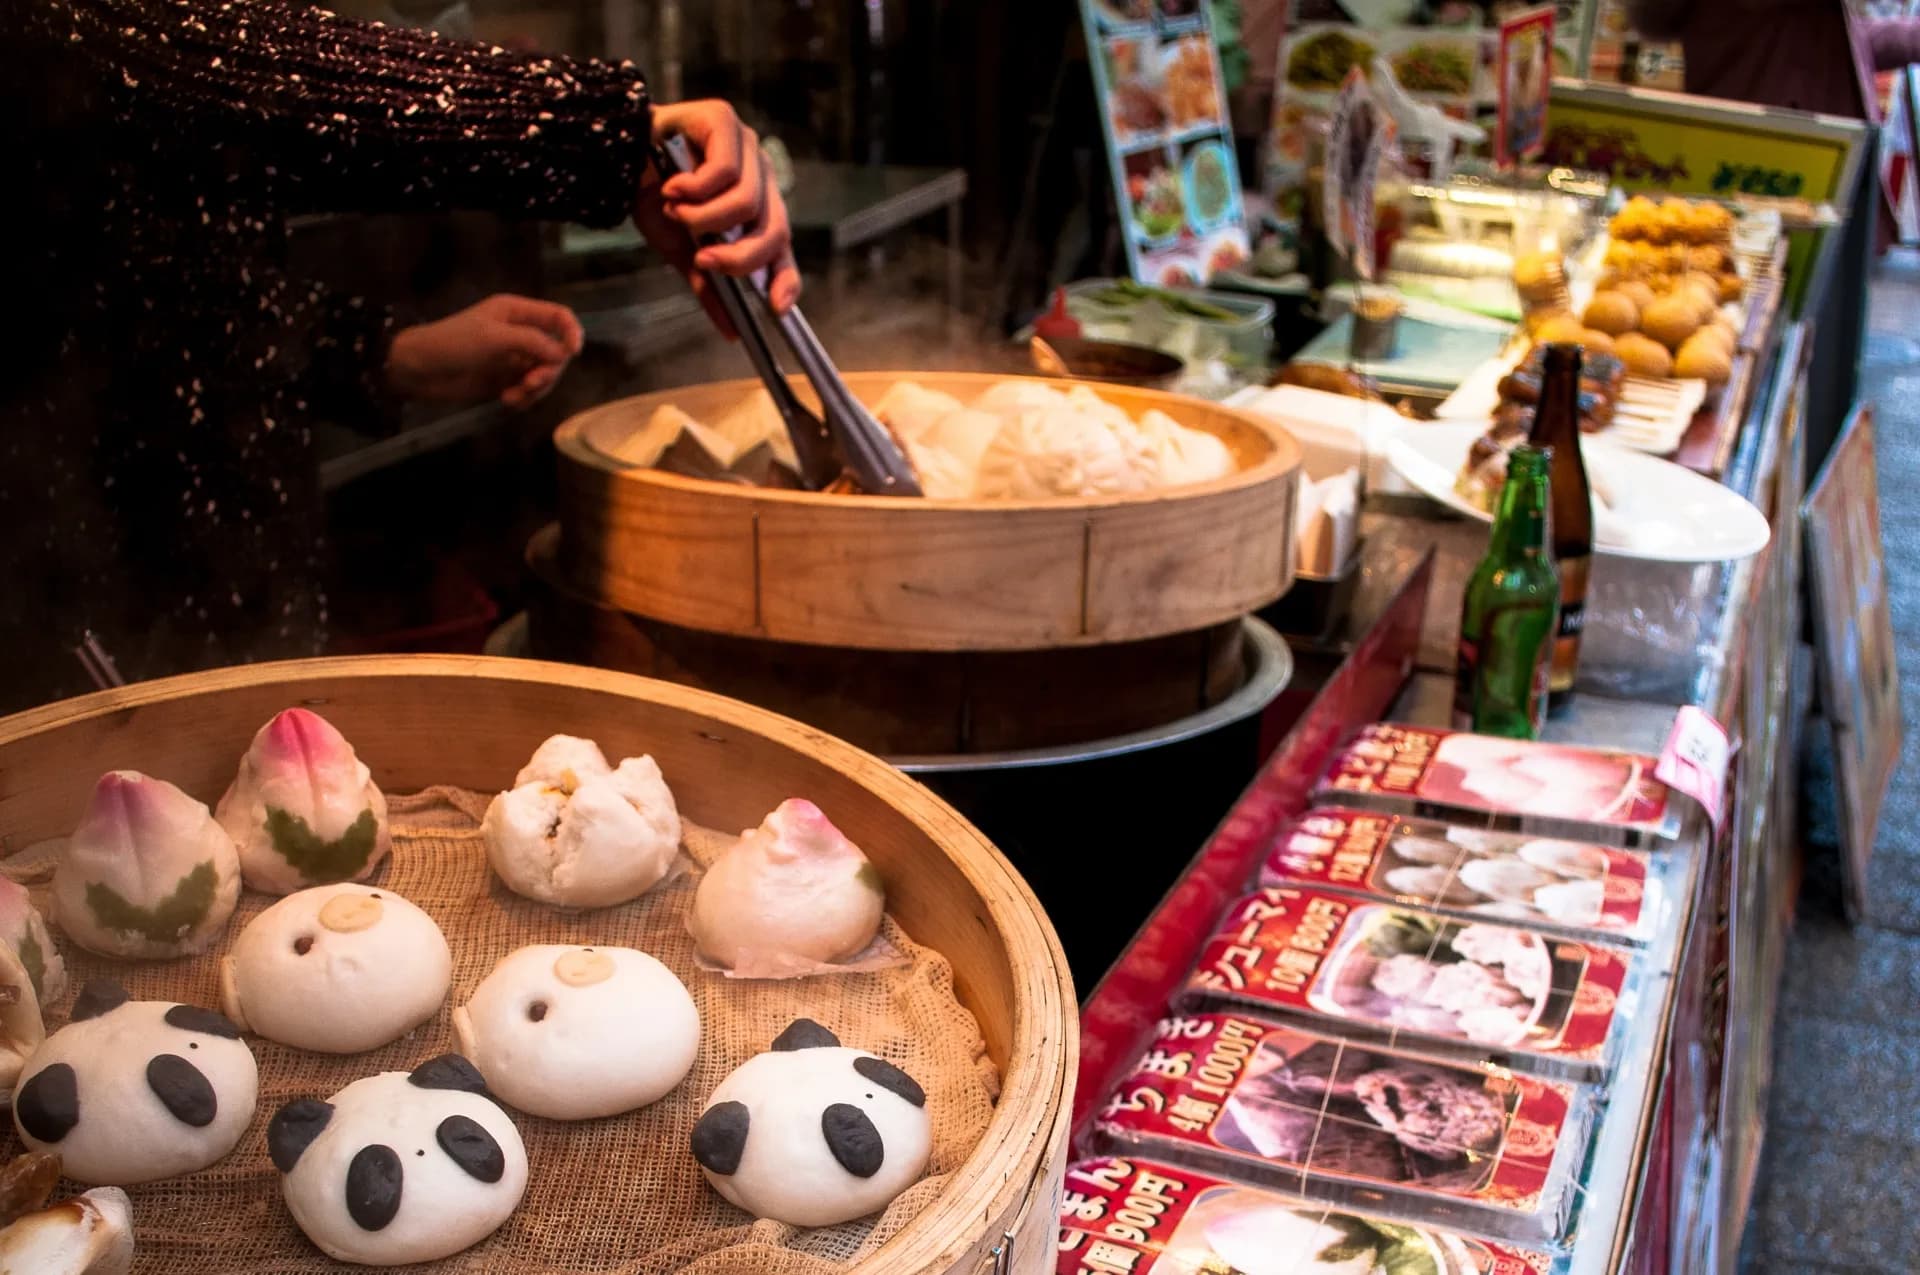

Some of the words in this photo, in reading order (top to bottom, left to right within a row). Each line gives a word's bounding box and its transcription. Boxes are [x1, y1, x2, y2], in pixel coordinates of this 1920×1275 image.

[1190, 888, 1302, 991] シューマイ
[1105, 1017, 1214, 1118] ちまき
[1192, 1018, 1264, 1097] 1000円
[1105, 1171, 1185, 1244] 900円
